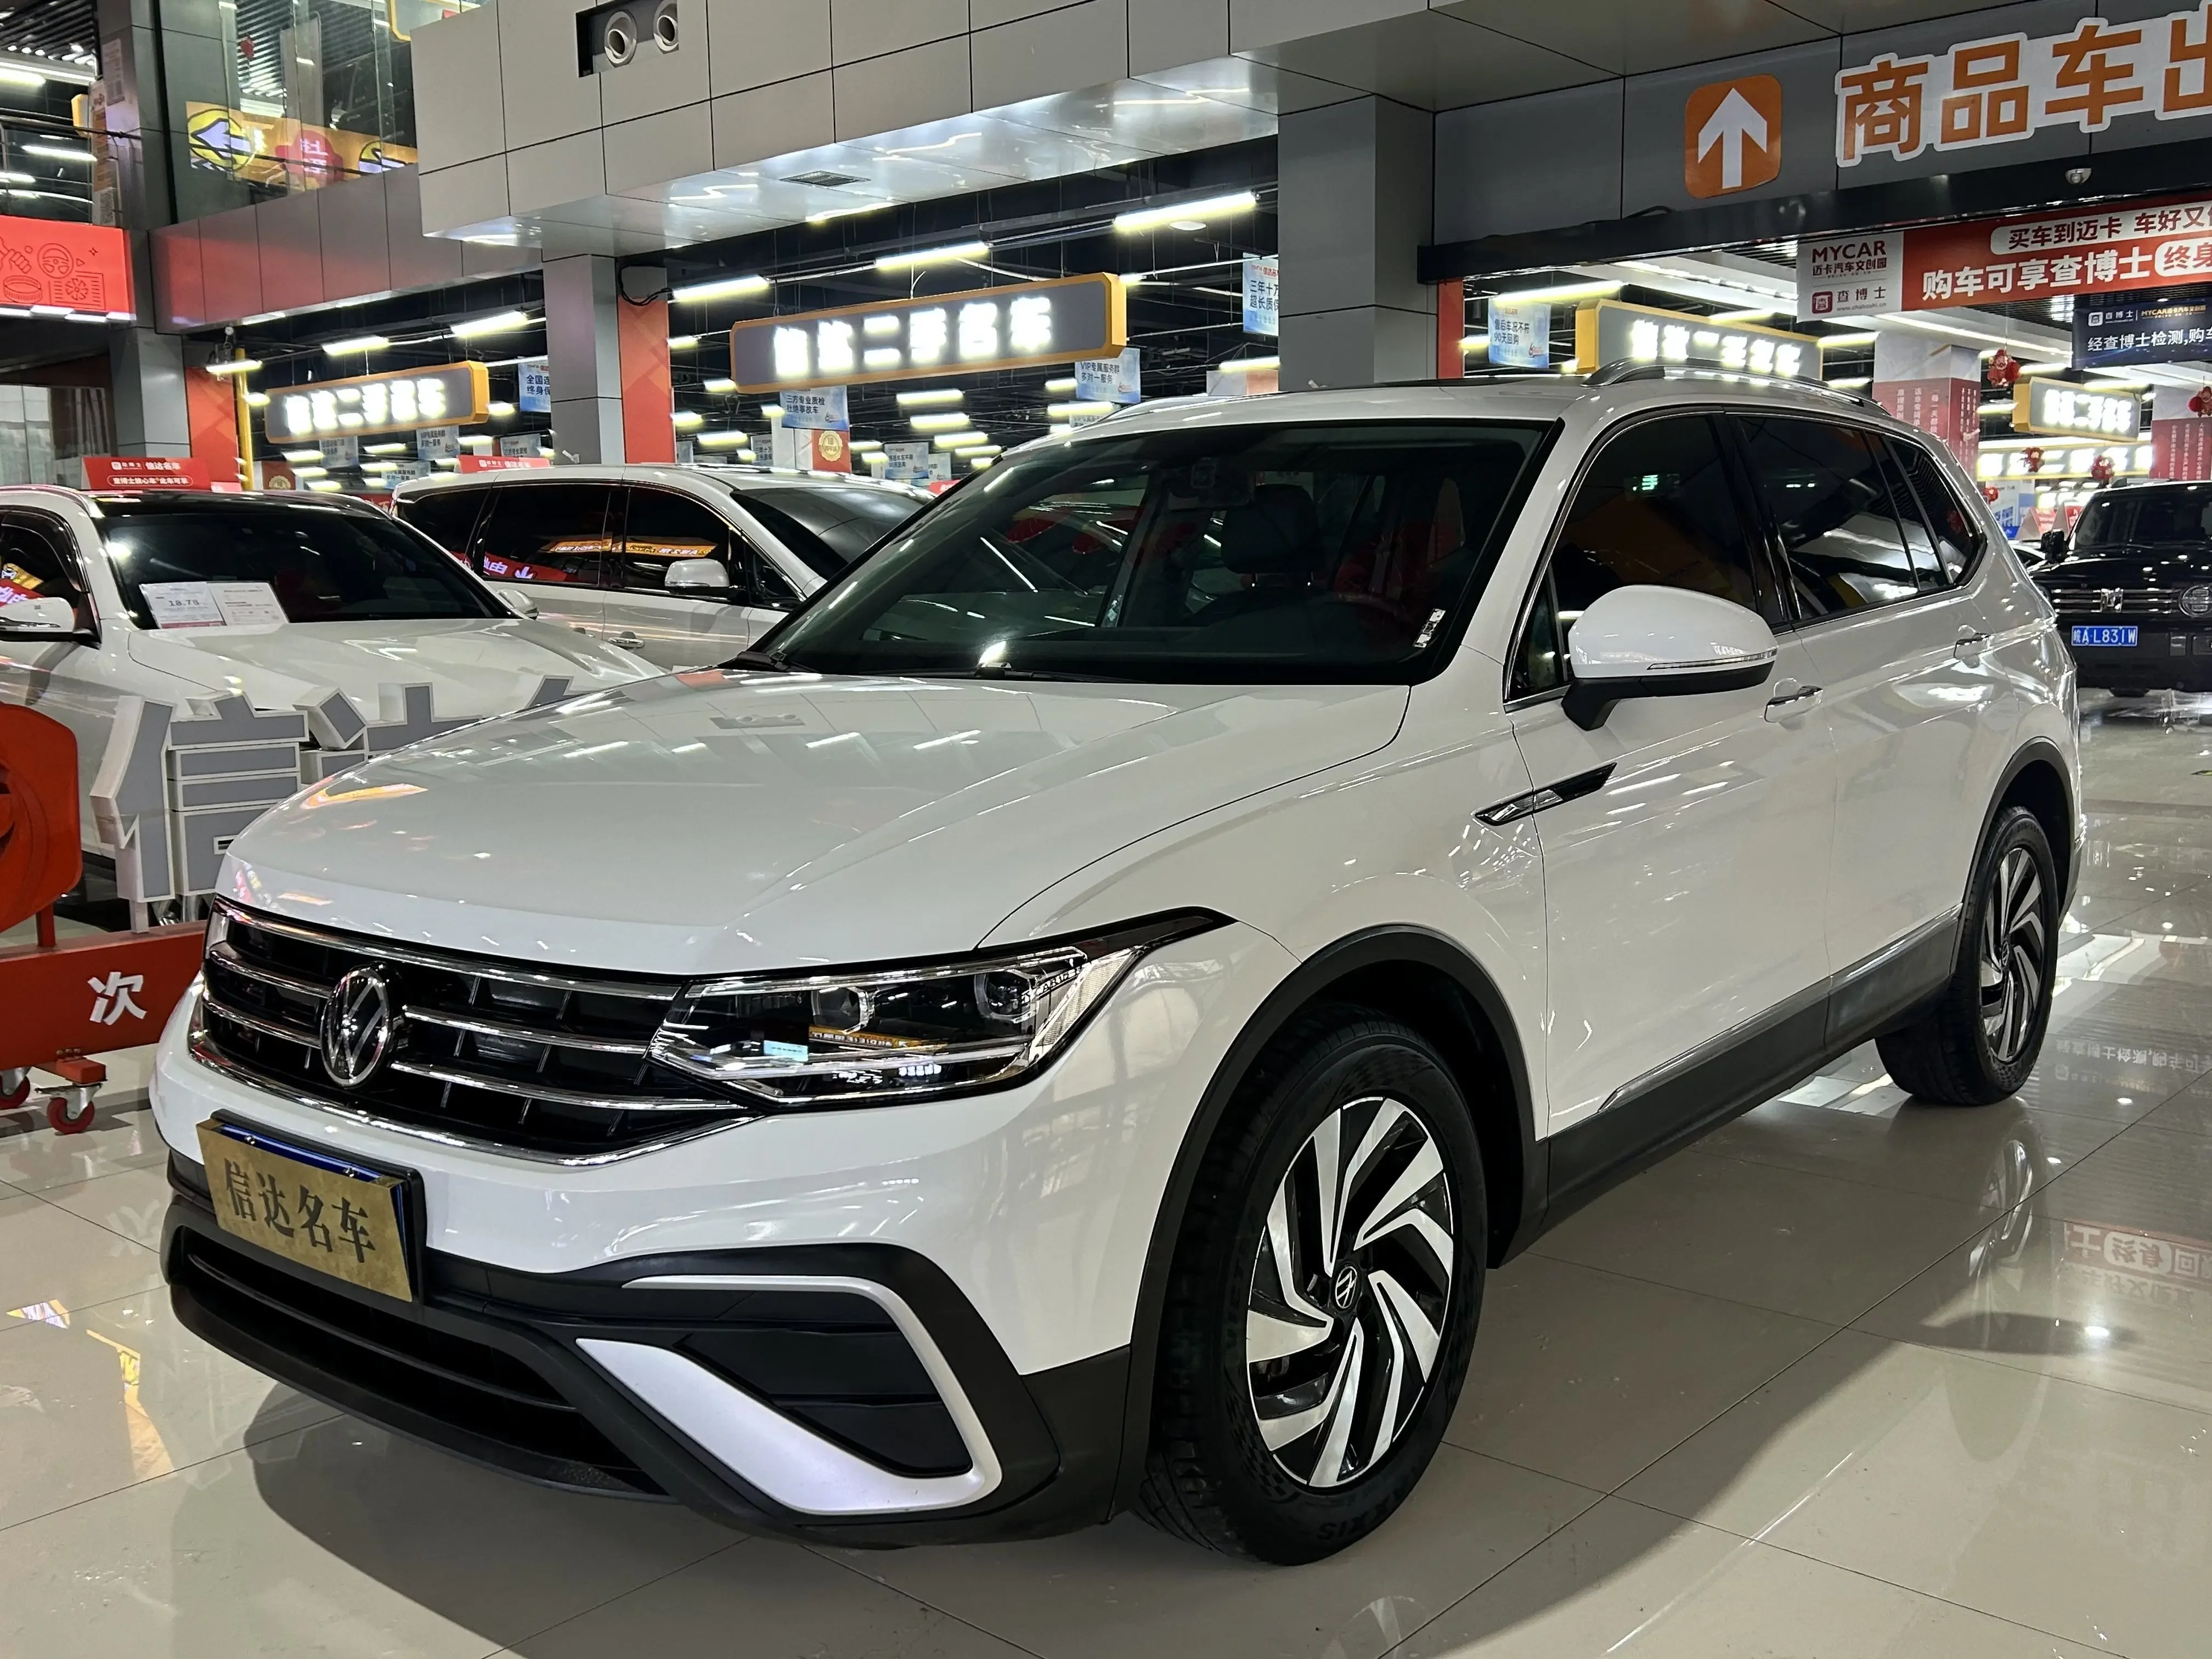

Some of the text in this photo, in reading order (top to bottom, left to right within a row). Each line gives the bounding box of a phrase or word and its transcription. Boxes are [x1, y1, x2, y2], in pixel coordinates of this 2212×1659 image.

[2008, 217, 2123, 250] 买车到迈卡
[1812, 240, 1887, 263] MYCAR
[1812, 257, 1887, 276] 迈卡汽车文创园
[1837, 286, 1887, 303] 查博士
[786, 394, 826, 405] 三方专业质检
[88, 970, 149, 1025] 次
[224, 1157, 376, 1263] 信达名车
